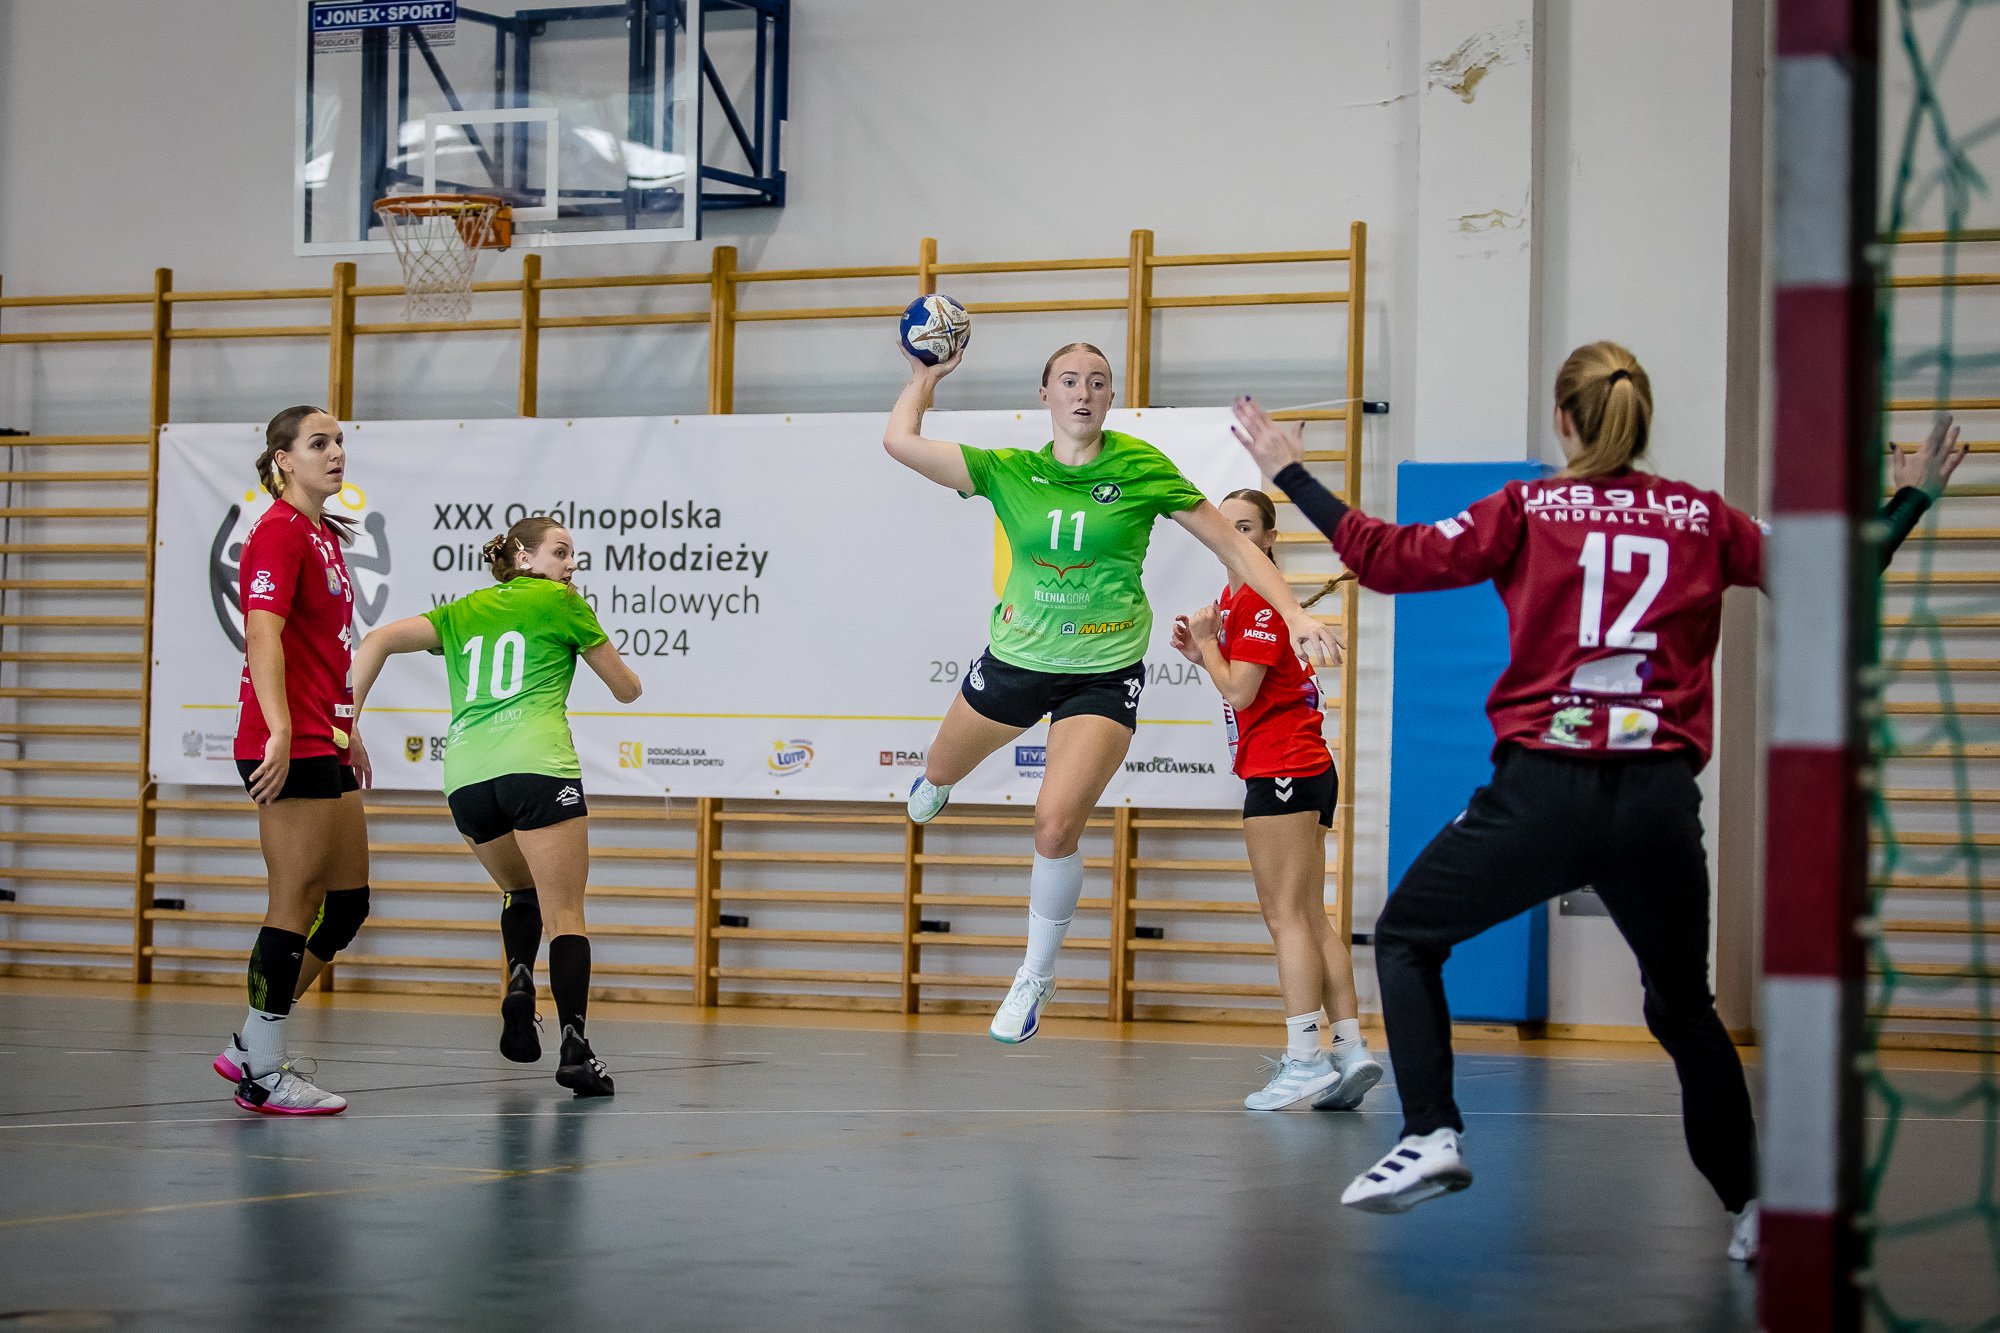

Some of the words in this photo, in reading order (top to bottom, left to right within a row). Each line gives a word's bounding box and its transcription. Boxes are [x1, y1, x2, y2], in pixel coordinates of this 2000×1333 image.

[433, 503, 494, 530] XXX
[1047, 509, 1086, 551] 11
[605, 542, 769, 578] Młodzieży
[612, 585, 760, 621] halowych
[1034, 590, 1066, 604] JELENIA
[1577, 531, 1669, 650] 12
[614, 629, 690, 656] 2024
[462, 630, 526, 702] 10
[930, 661, 958, 683] 29
[647, 758, 690, 766] FEDERACJA
[693, 758, 724, 767] SPORTU
[1125, 762, 1215, 773] WROCŁAWSKA
